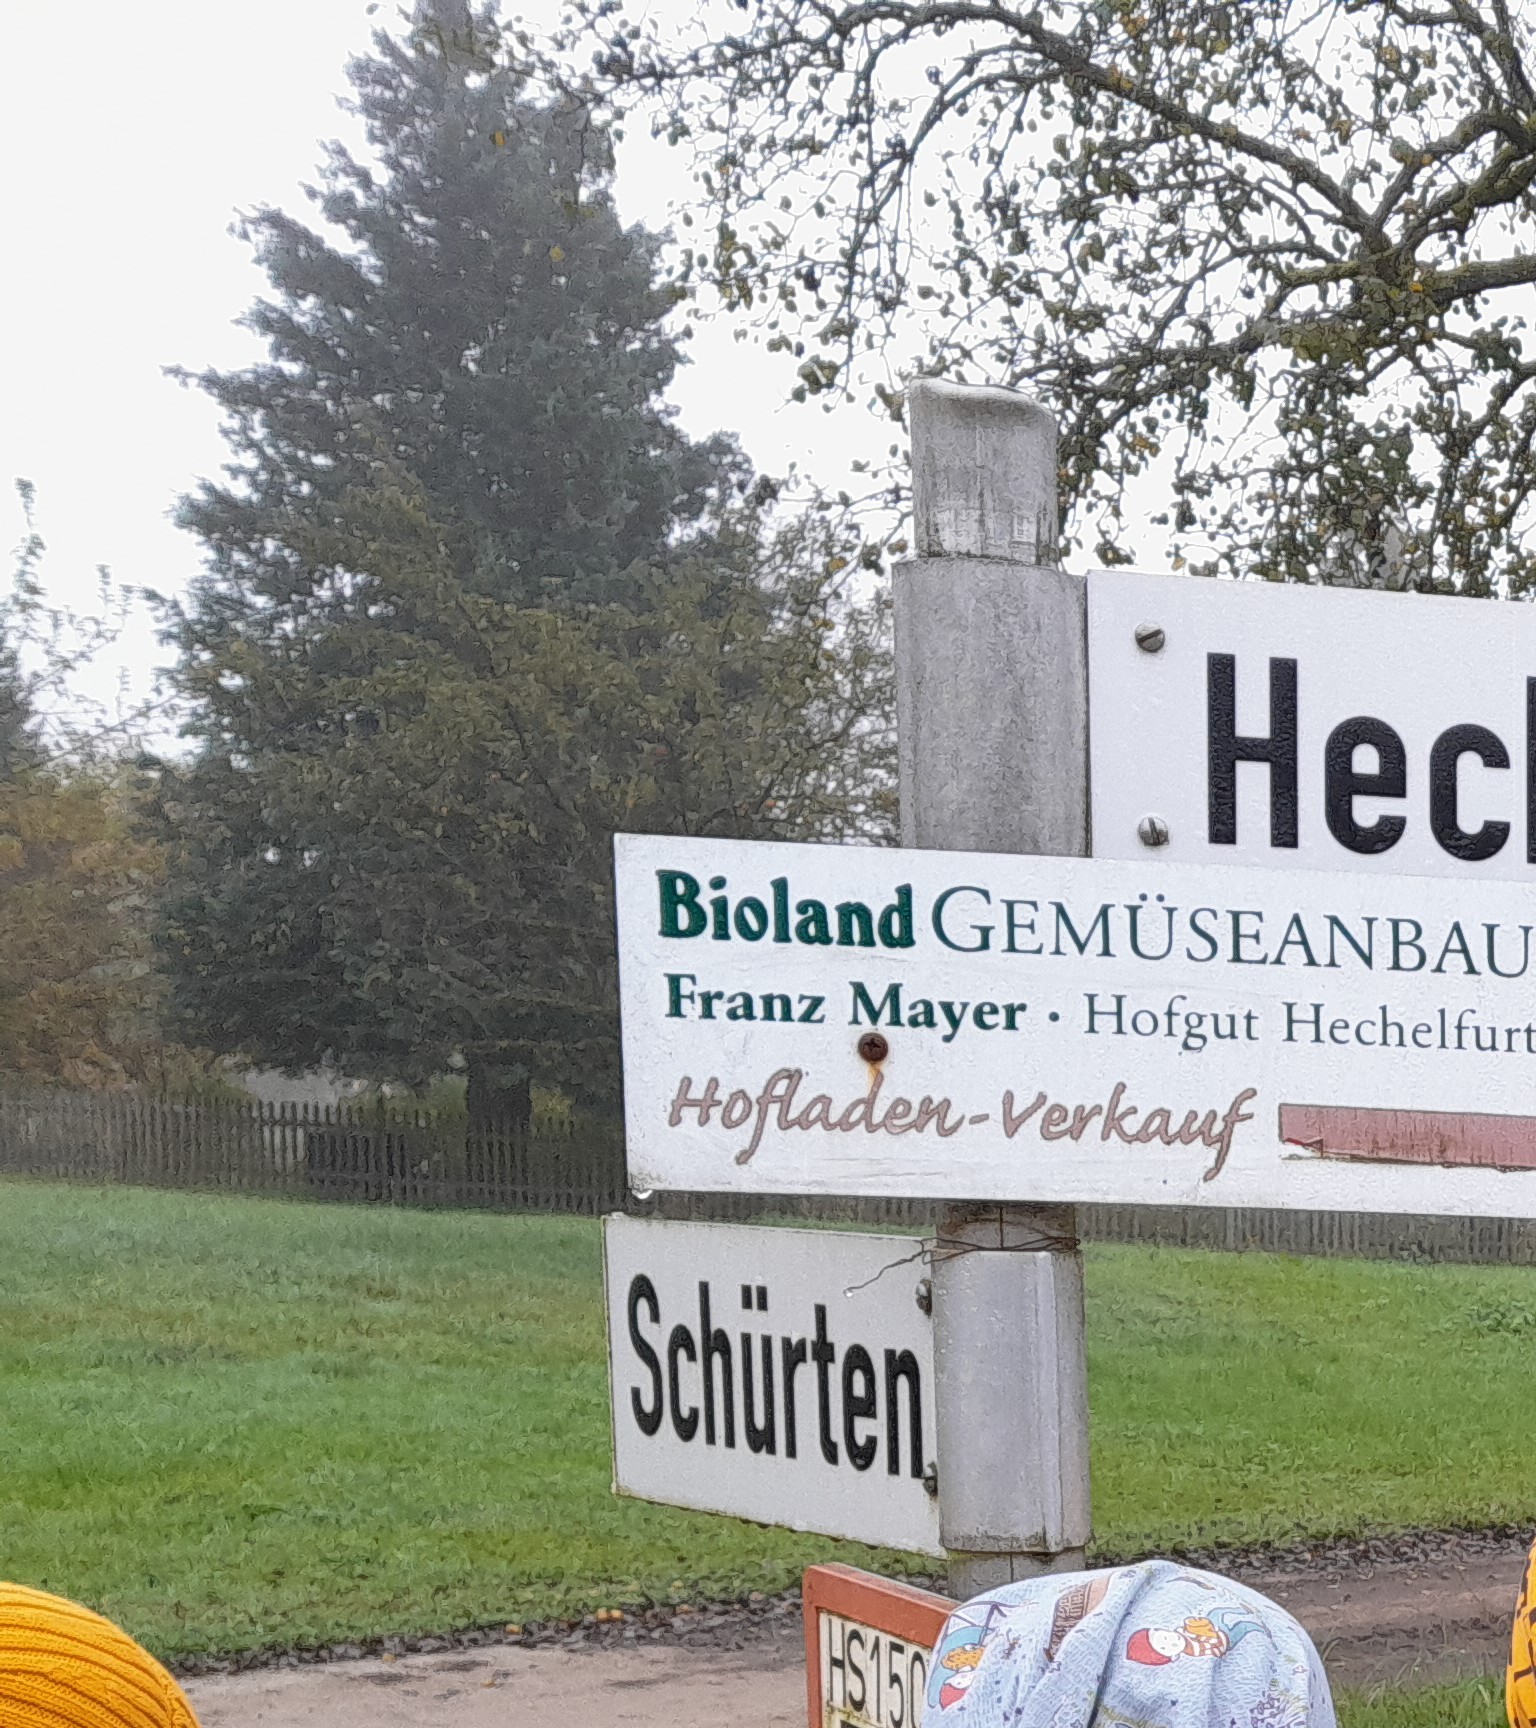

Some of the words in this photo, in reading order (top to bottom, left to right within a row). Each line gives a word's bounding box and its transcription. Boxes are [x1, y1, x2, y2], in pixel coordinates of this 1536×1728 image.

[655, 868, 917, 950] Bioland
[931, 885, 1534, 979] GEMÜSEANBAU
[663, 972, 825, 1024] Franz
[847, 981, 1028, 1044] Mayer
[1083, 993, 1260, 1053] Hofgut
[668, 1067, 1258, 1182] Hofladen-Verkauf
[627, 1273, 924, 1479] Schürten
